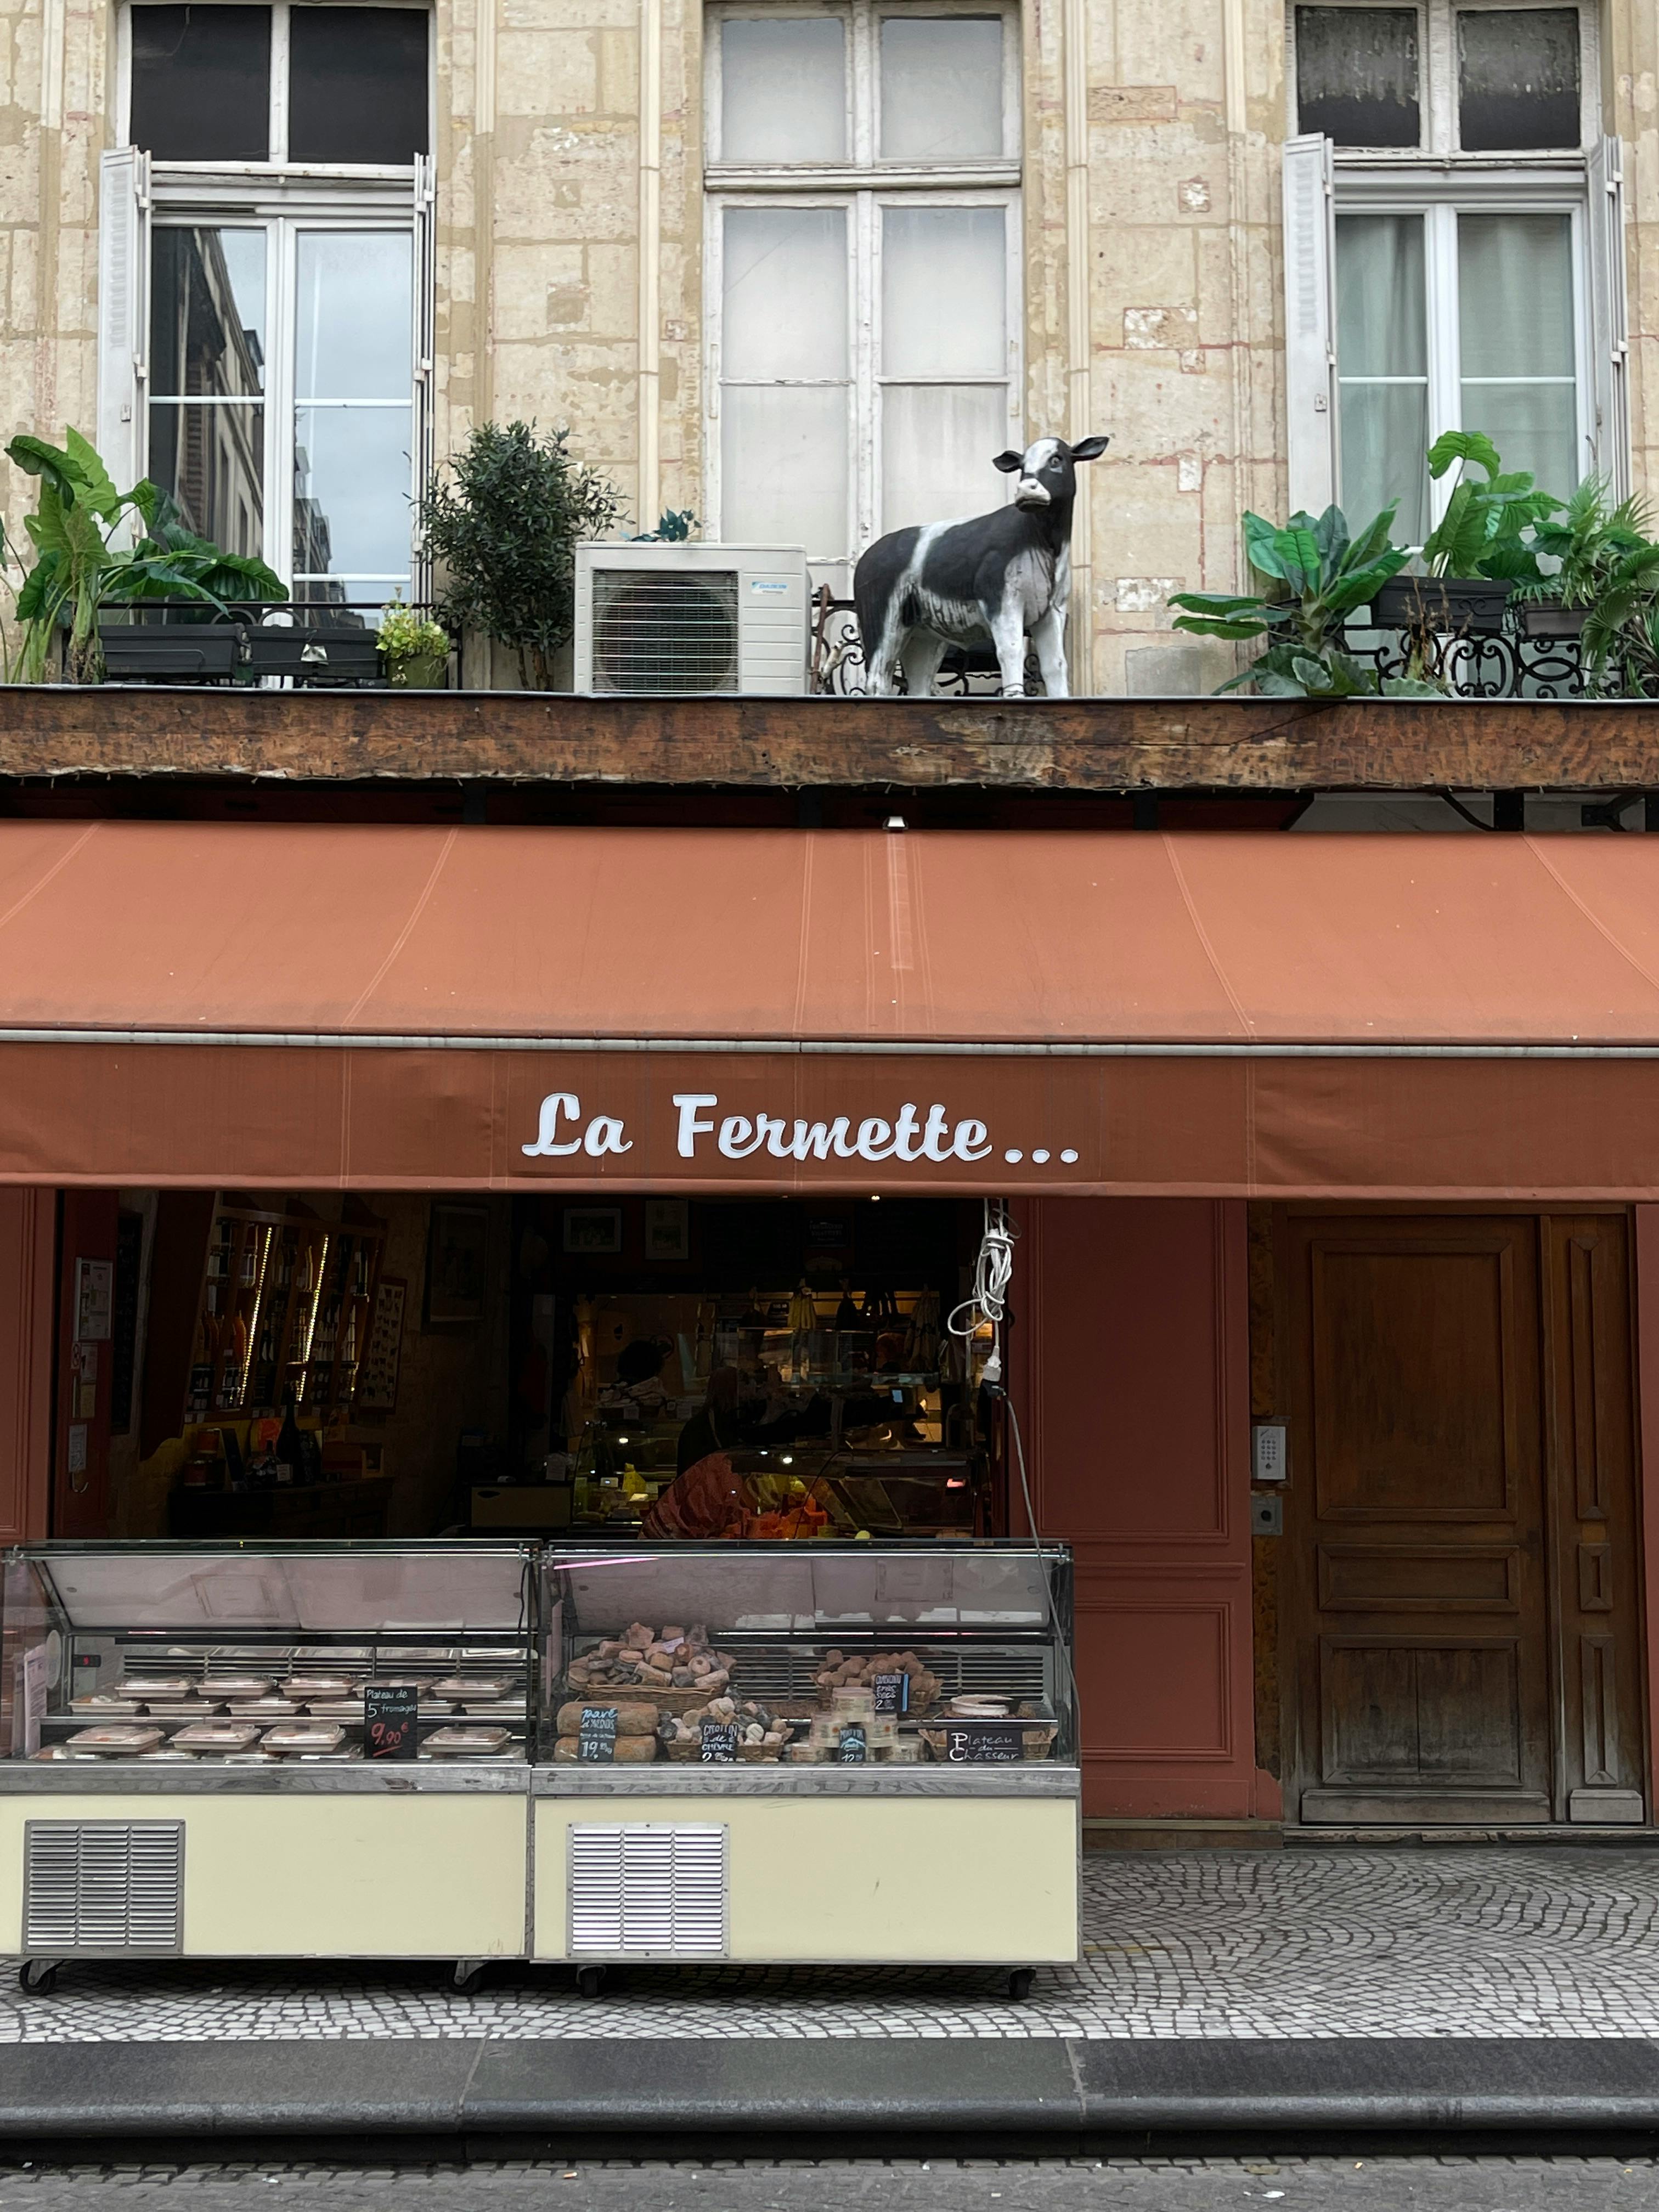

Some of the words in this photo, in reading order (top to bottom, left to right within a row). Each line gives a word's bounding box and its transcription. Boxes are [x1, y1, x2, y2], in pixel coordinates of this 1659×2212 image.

[522, 1092, 633, 1157] La
[366, 1689, 394, 1699] Plateau
[396, 1689, 408, 1699] de
[368, 1702, 381, 1718] 5
[951, 1733, 1013, 1751] Plateau
[949, 1747, 1019, 1761] Chasseur
